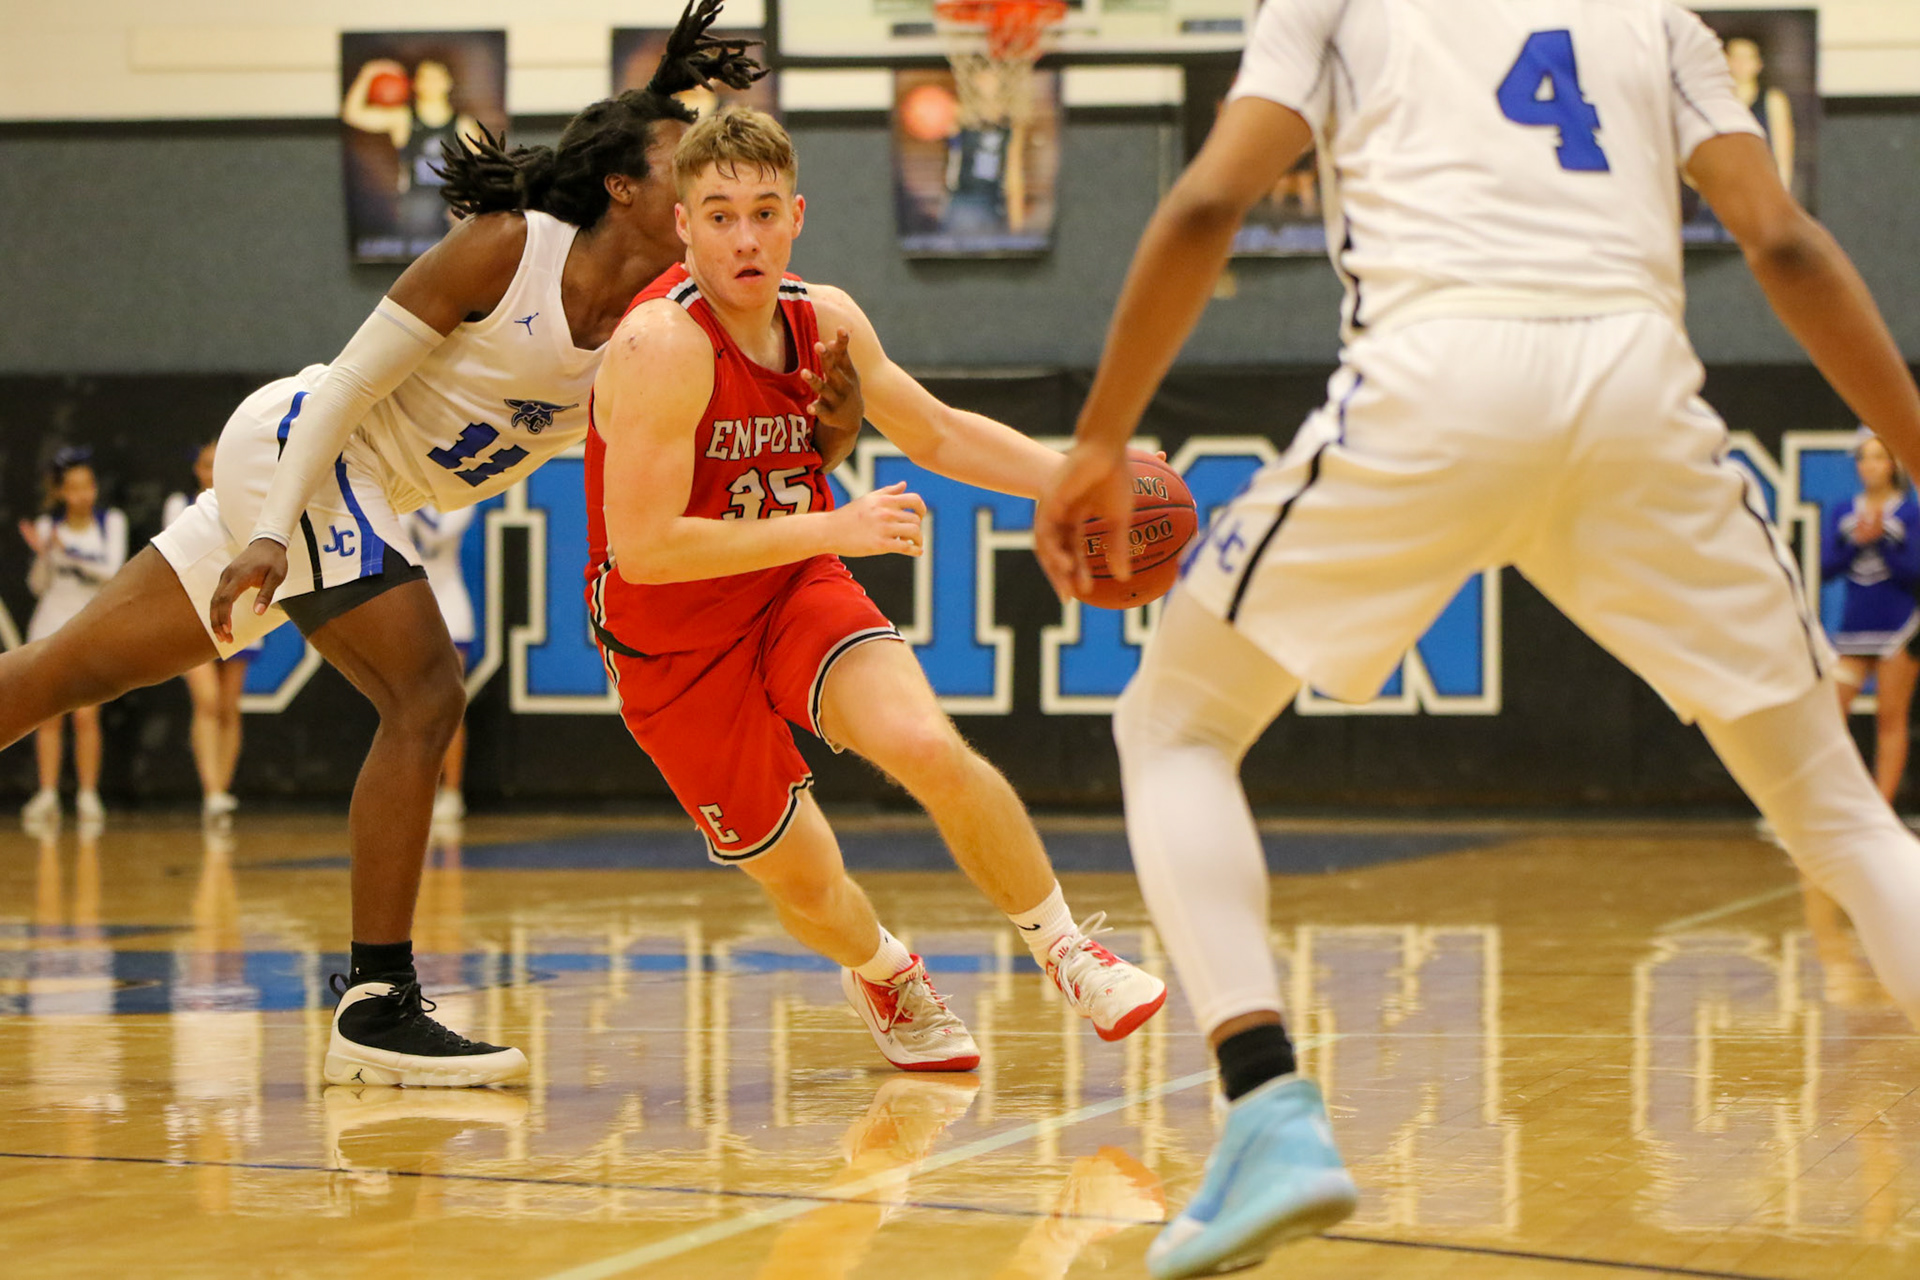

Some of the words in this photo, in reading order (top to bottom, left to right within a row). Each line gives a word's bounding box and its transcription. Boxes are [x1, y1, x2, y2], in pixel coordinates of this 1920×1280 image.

[1496, 29, 1611, 172] 4
[427, 421, 530, 487] 11
[705, 414, 815, 460] EMPOR
[721, 466, 813, 520] 35
[323, 525, 355, 557] JC
[697, 803, 741, 844] E
